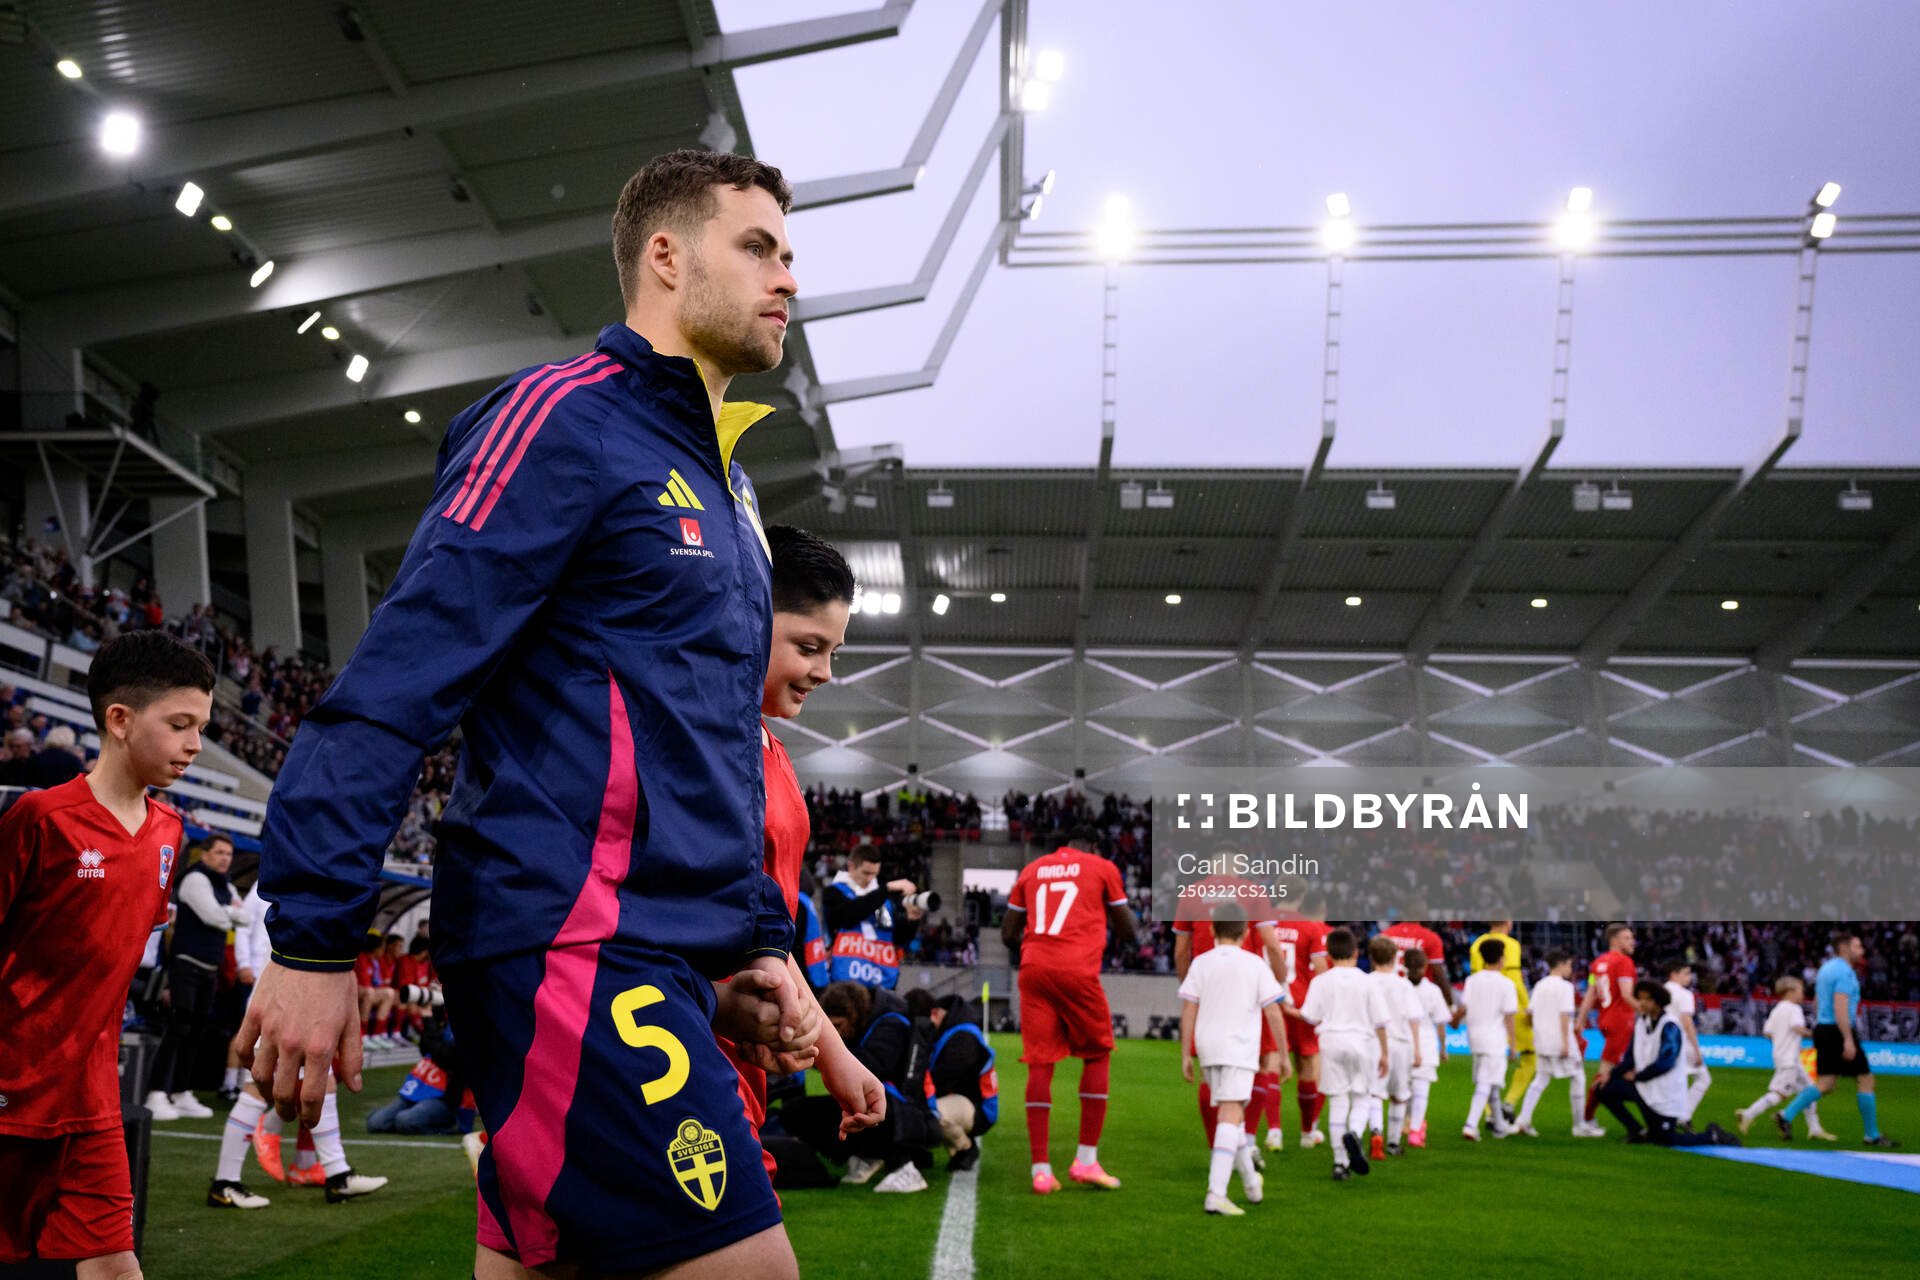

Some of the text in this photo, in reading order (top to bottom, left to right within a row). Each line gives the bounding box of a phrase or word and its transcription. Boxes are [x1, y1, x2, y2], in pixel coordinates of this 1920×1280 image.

[670, 548, 701, 556] SVENSKA
[1034, 881, 1079, 935] 17
[838, 935, 896, 963] PHOTO
[610, 984, 691, 1106] 5
[677, 1142, 715, 1158] SVERIGE
